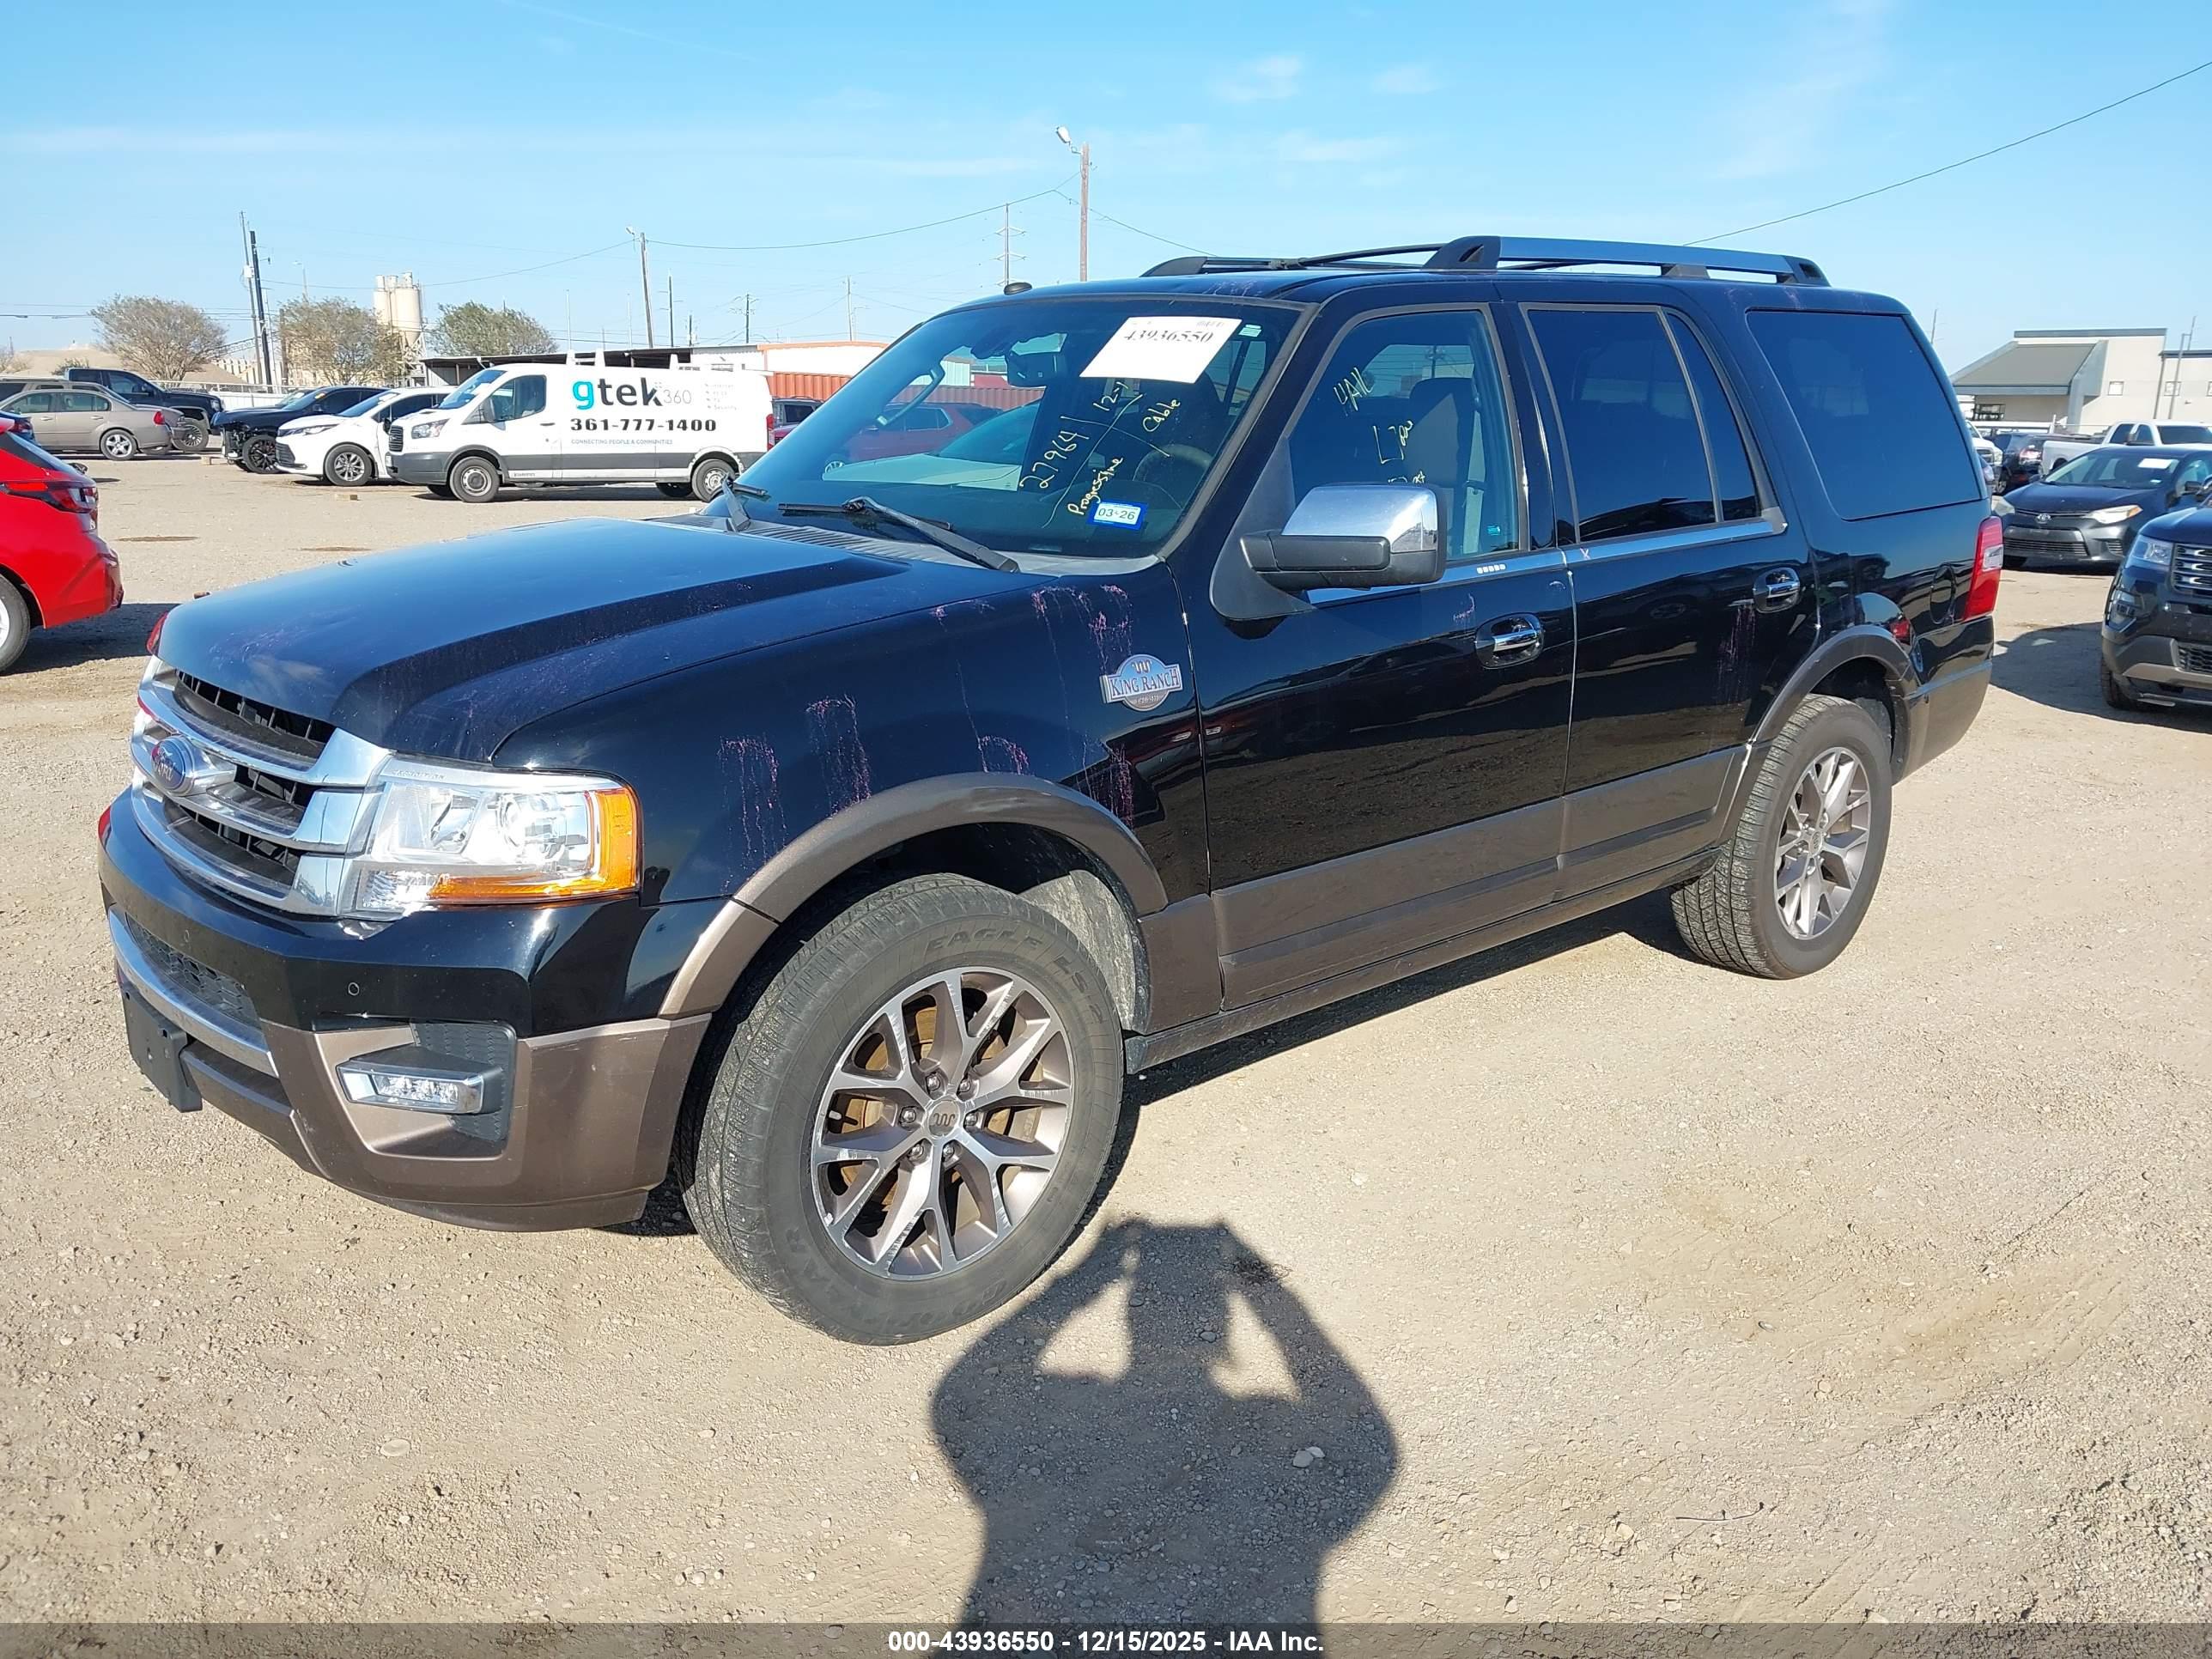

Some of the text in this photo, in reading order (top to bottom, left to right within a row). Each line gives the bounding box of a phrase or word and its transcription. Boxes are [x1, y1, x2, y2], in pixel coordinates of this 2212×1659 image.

[1124, 330, 1214, 343] 43936550
[572, 377, 663, 410] gtek
[570, 418, 716, 431] 361-777-1400
[1142, 398, 1181, 432] Cable
[1019, 430, 1090, 489] 27964
[1109, 669, 1180, 696] KING RANCH
[928, 927, 1043, 950] EAGLE
